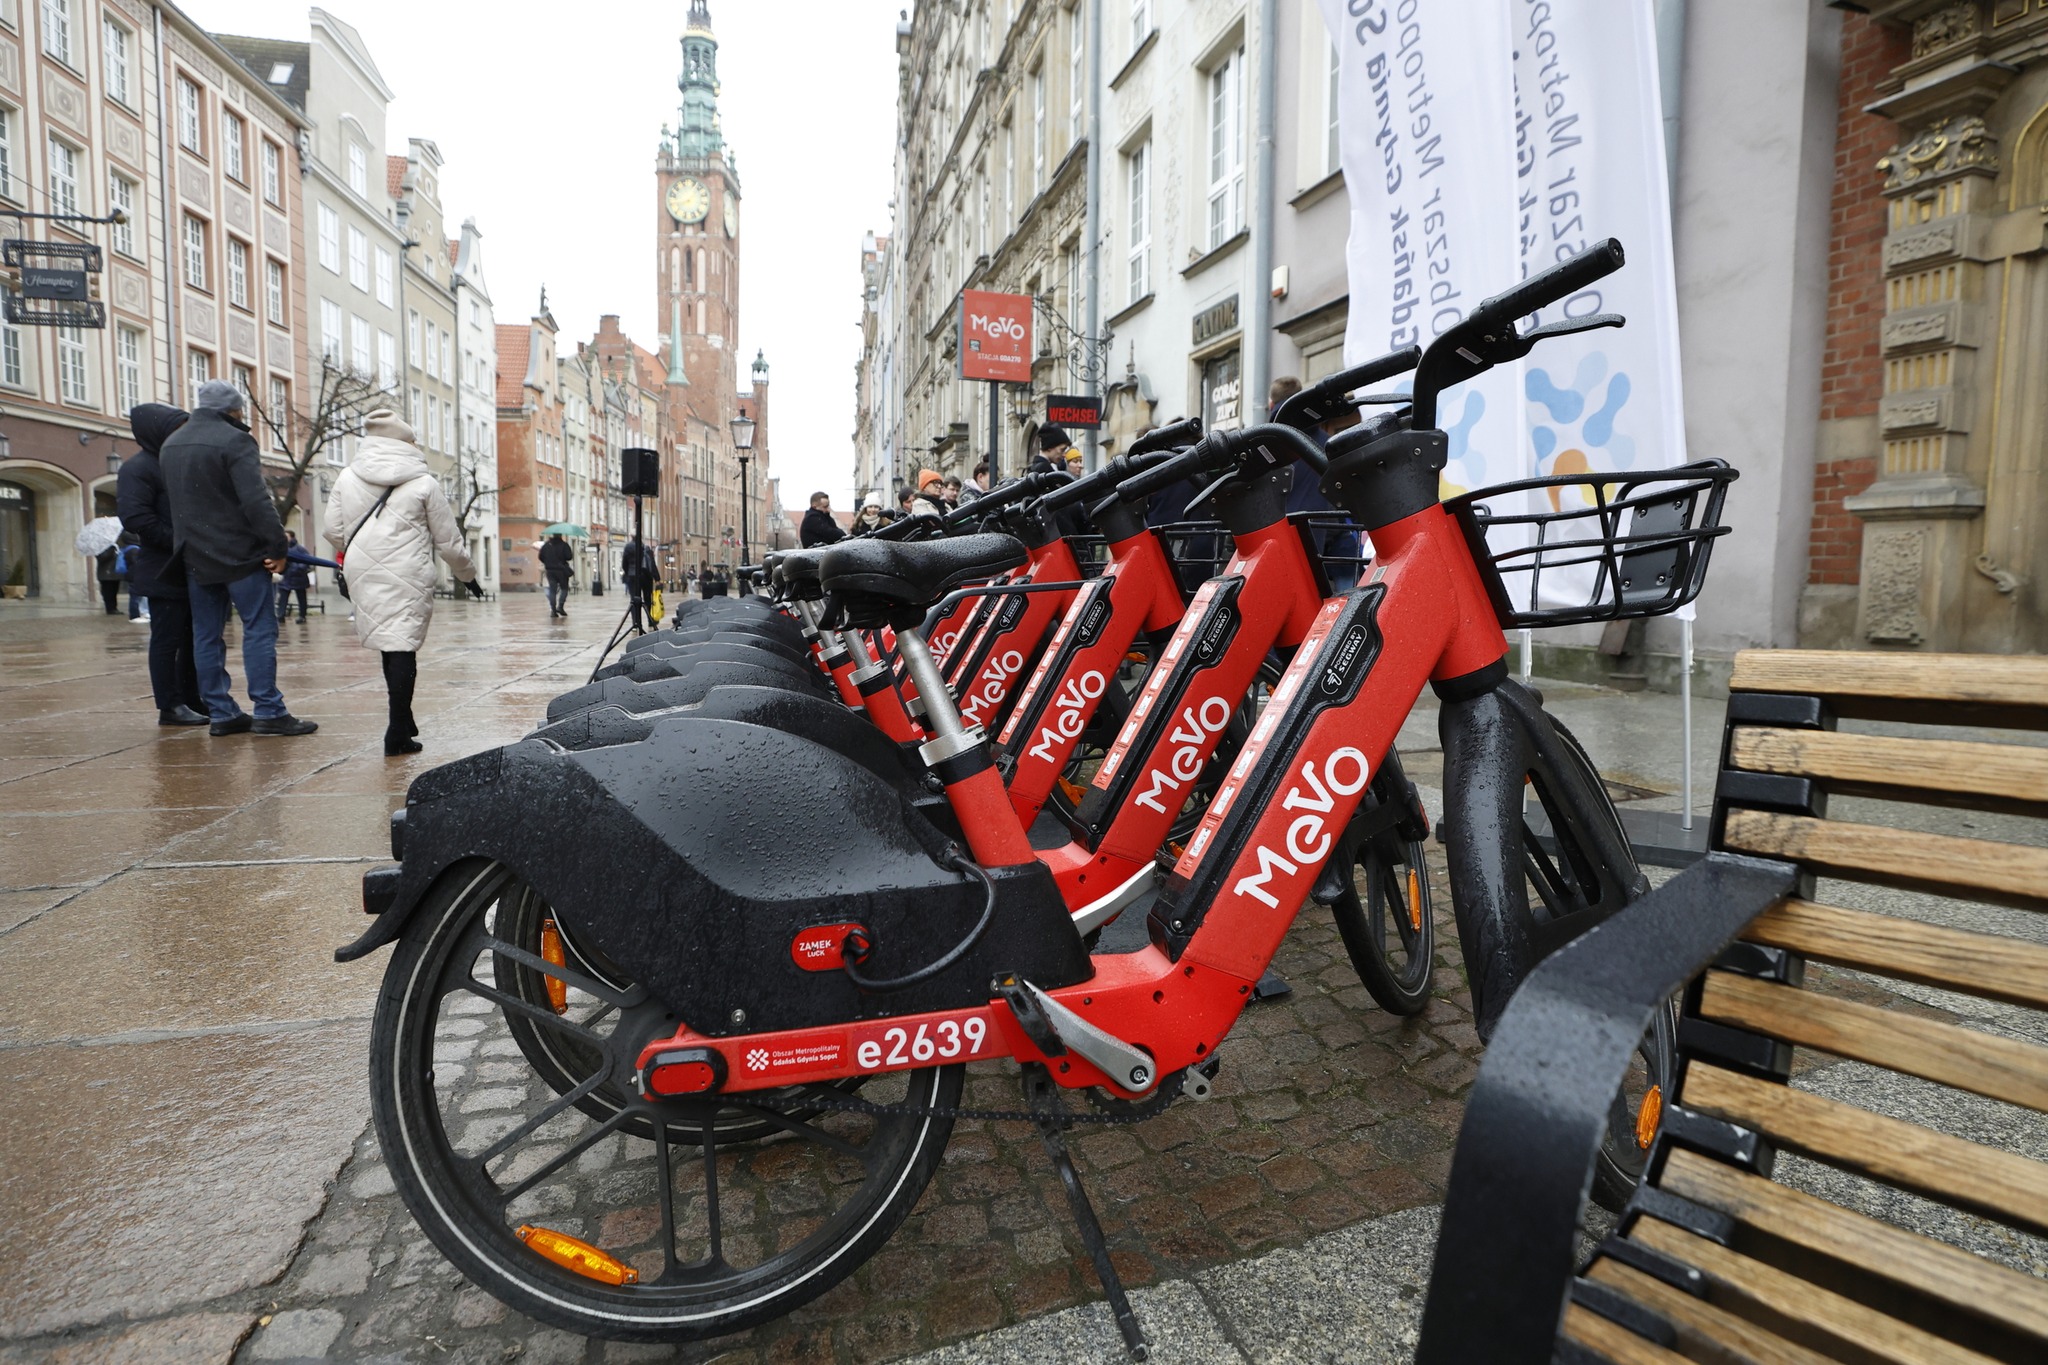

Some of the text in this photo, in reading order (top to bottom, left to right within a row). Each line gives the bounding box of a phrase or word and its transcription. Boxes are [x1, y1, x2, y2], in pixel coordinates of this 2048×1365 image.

[1048, 407, 1099, 424] WECHSEL
[1333, 630, 1357, 669] POWERED BY
[1338, 633, 1362, 673] SEGWAY
[799, 939, 832, 951] ZAMEK
[807, 950, 825, 958] LUCK
[857, 1017, 986, 1069] e2639
[772, 1045, 841, 1058] Obszar Metropolitalny
[772, 1053, 838, 1066] Gdańsk Gdynia Sopot
